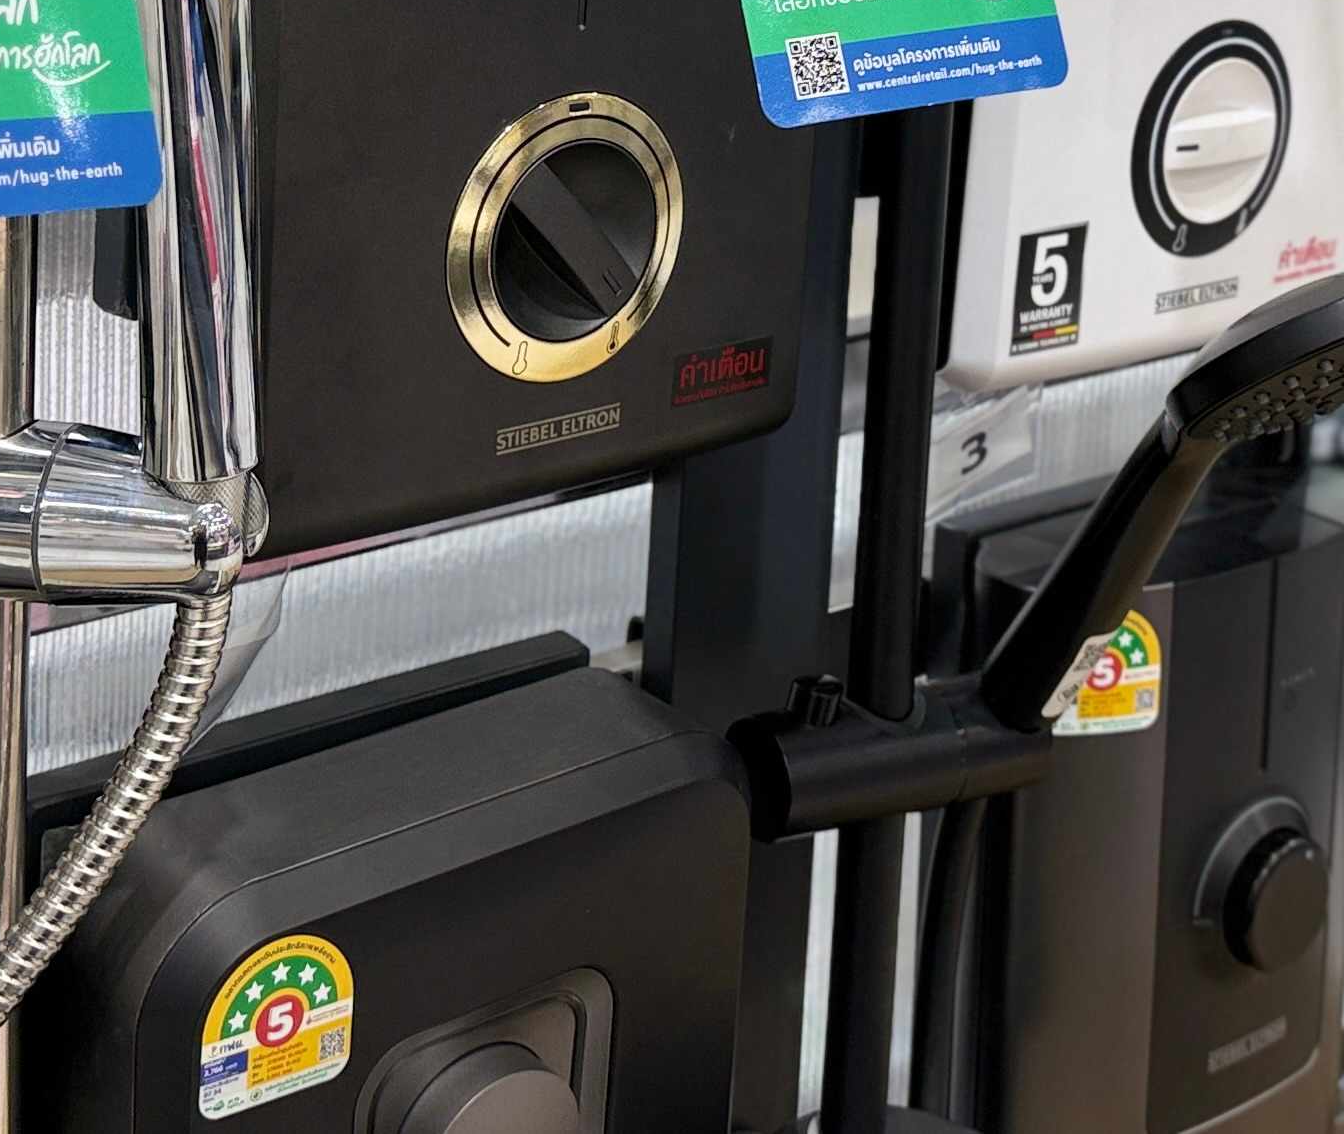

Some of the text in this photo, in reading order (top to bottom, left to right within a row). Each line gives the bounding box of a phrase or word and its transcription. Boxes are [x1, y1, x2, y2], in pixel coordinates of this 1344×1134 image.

[1031, 232, 1070, 308] 5
[496, 408, 621, 452] STIEBEL ELTRON
[960, 431, 987, 476] 3
[266, 1001, 295, 1042] 5
